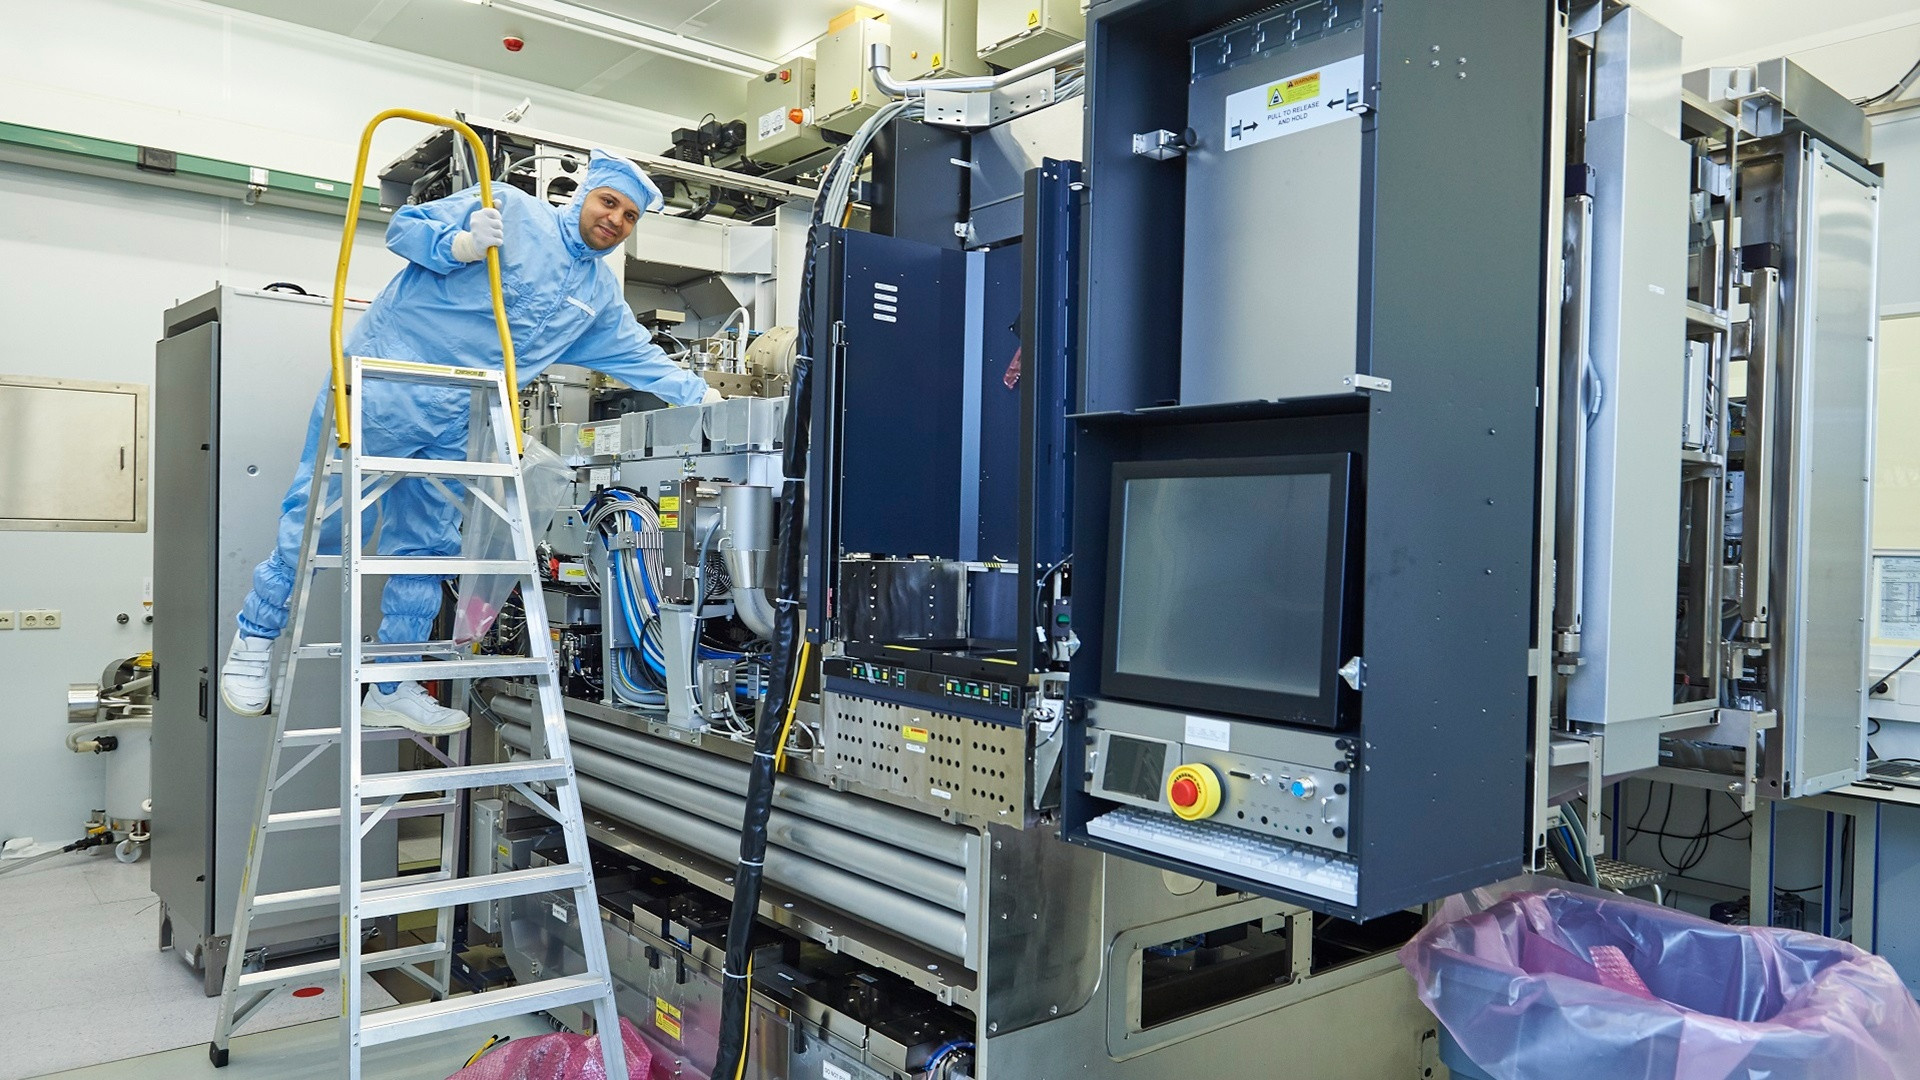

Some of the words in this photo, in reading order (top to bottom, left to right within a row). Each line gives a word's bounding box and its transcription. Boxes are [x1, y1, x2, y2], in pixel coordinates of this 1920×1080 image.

[1294, 74, 1318, 85] WARNING
[1267, 112, 1281, 120] PULL
[1292, 101, 1320, 113] RELEASE
[1278, 118, 1290, 126] AND
[1291, 113, 1308, 122] HOLD
